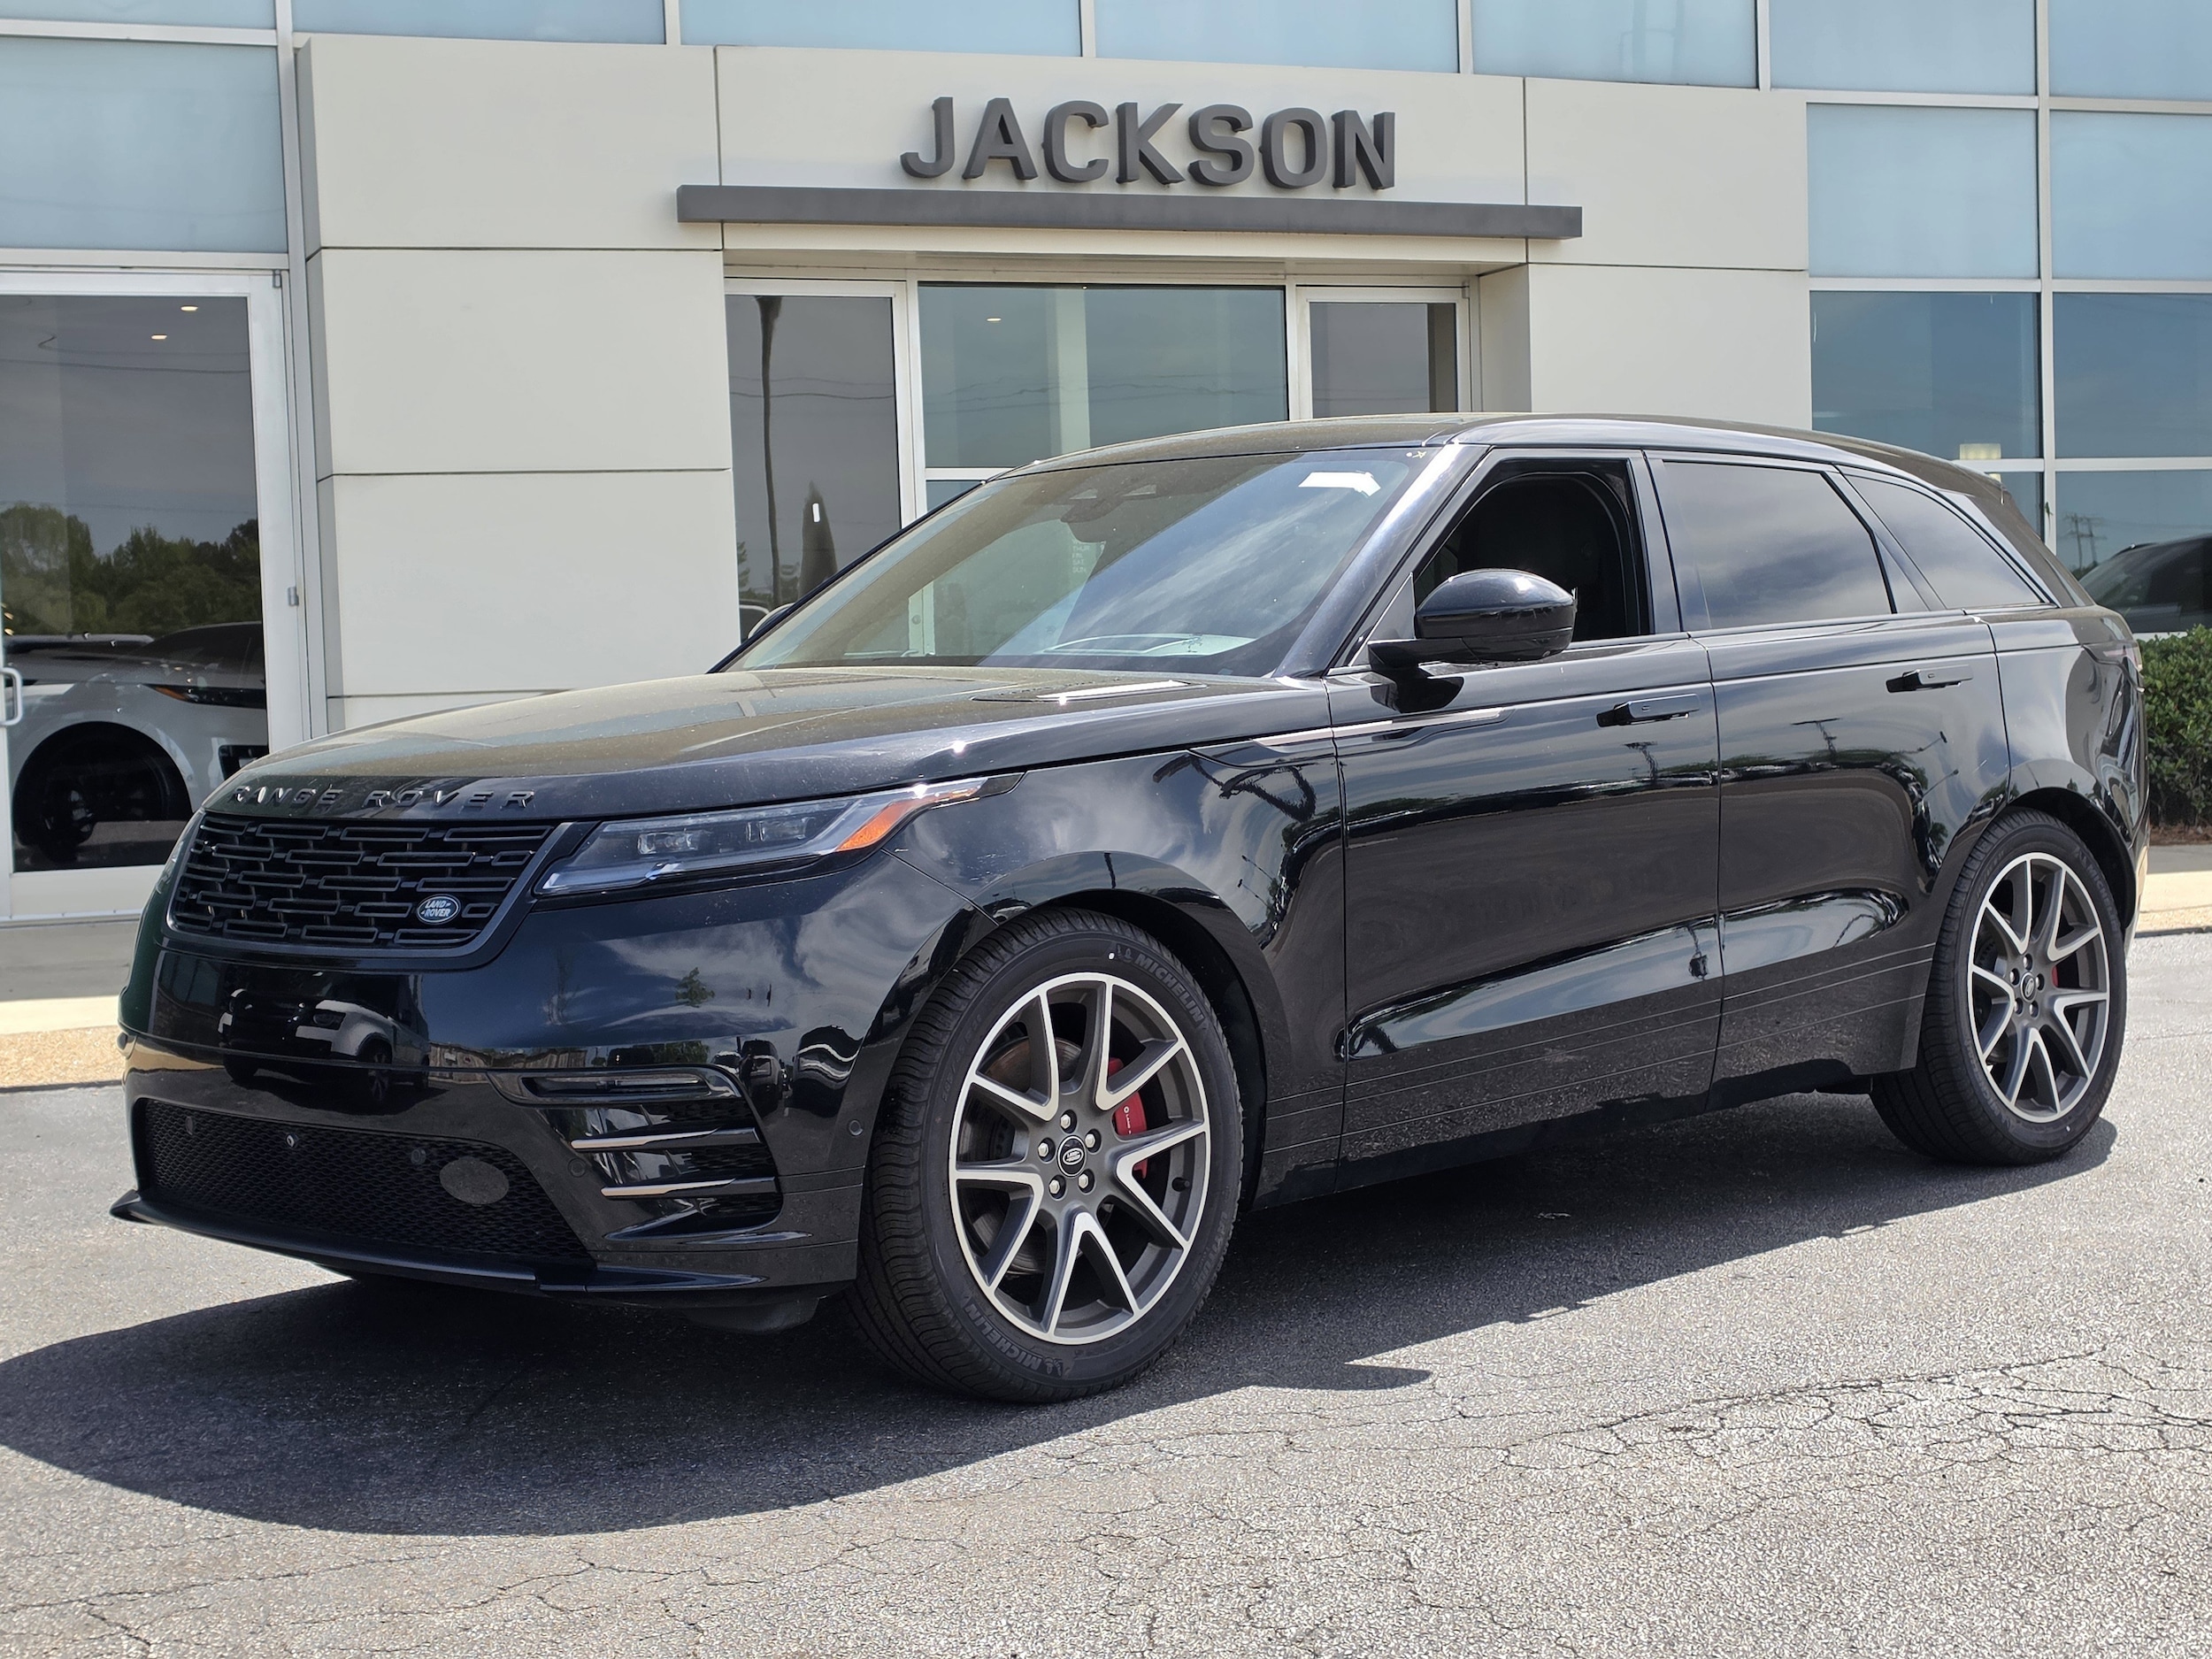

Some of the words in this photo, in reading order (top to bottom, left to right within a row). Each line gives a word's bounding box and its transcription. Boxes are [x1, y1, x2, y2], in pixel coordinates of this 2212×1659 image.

[900, 96, 1395, 190] JACKSON
[234, 785, 343, 805] RANGE
[362, 788, 535, 809] ROVER
[1133, 952, 1205, 1022] MICHELIN
[964, 1302, 1042, 1371] MICHELIN
